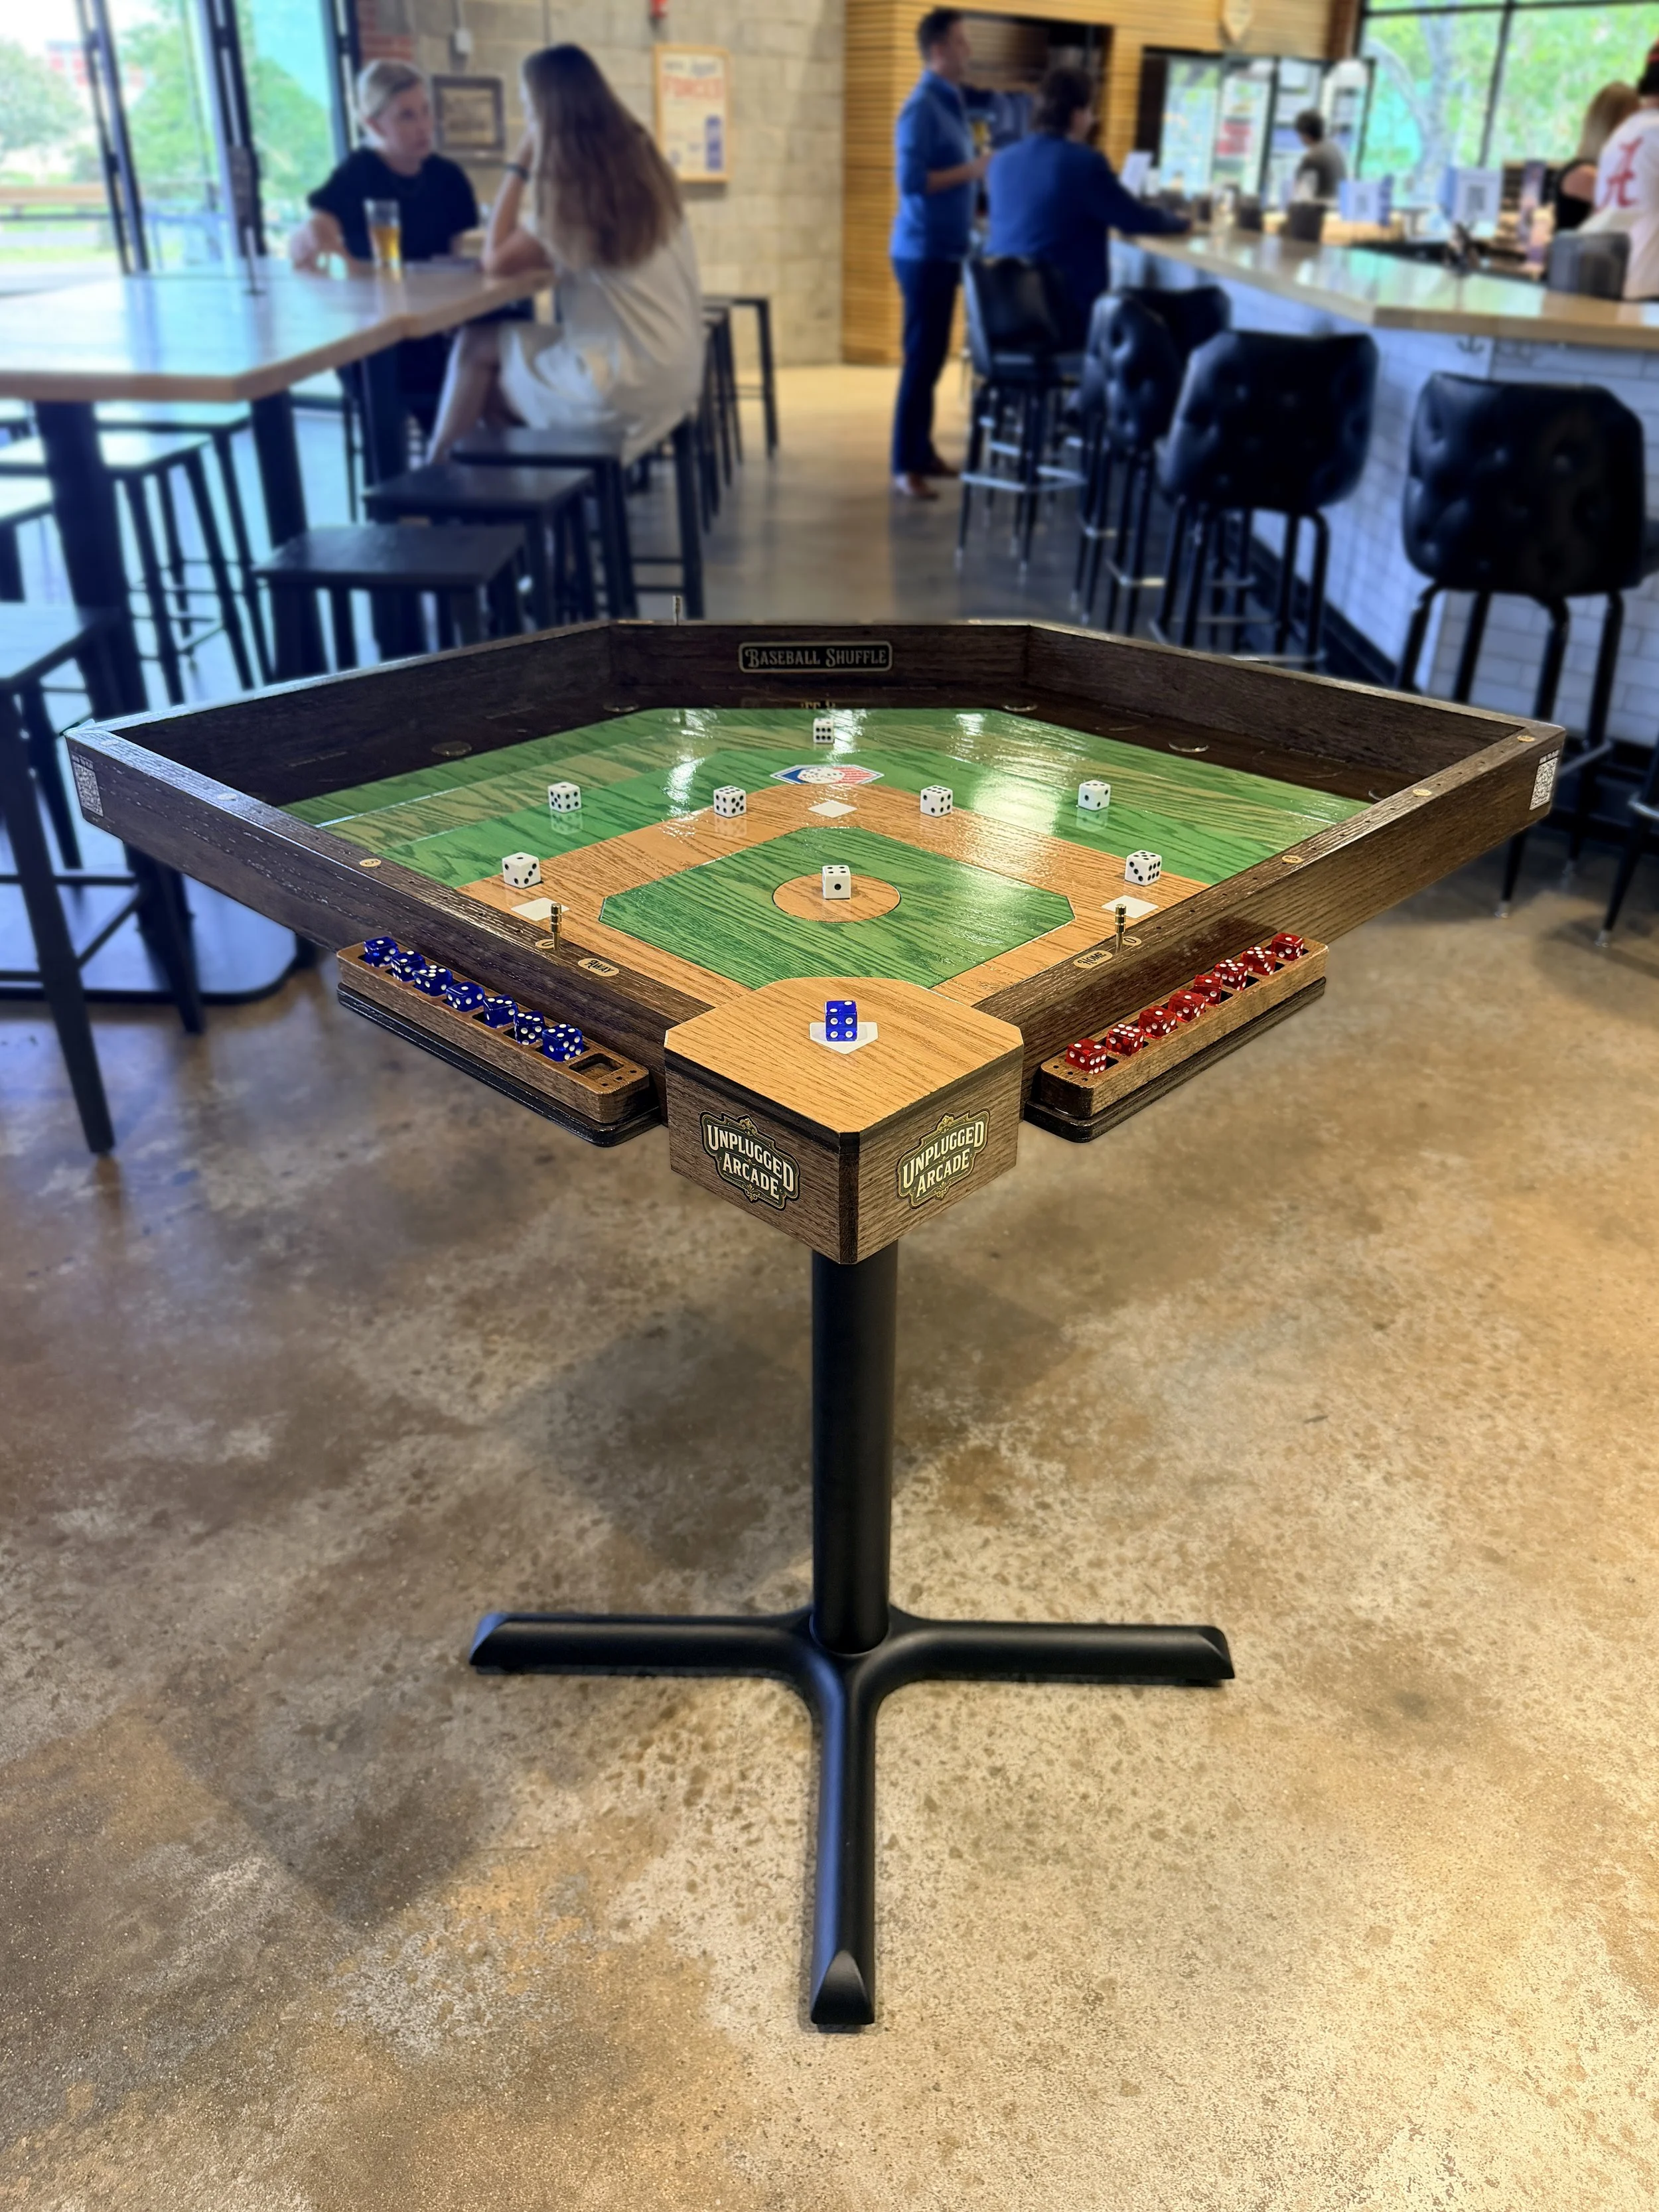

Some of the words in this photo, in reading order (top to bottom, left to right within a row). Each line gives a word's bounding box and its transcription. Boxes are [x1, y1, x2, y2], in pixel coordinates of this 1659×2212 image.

[745, 648, 821, 668] BASEBALL
[826, 648, 887, 667] SHUFFLE
[584, 959, 614, 973] AWAY
[1078, 952, 1107, 965] HOME
[706, 1124, 795, 1192] UNPLUGGED
[721, 1152, 780, 1200] ARCADE
[902, 1120, 985, 1189] UNPLUGGED
[916, 1148, 971, 1199] ARCADE
